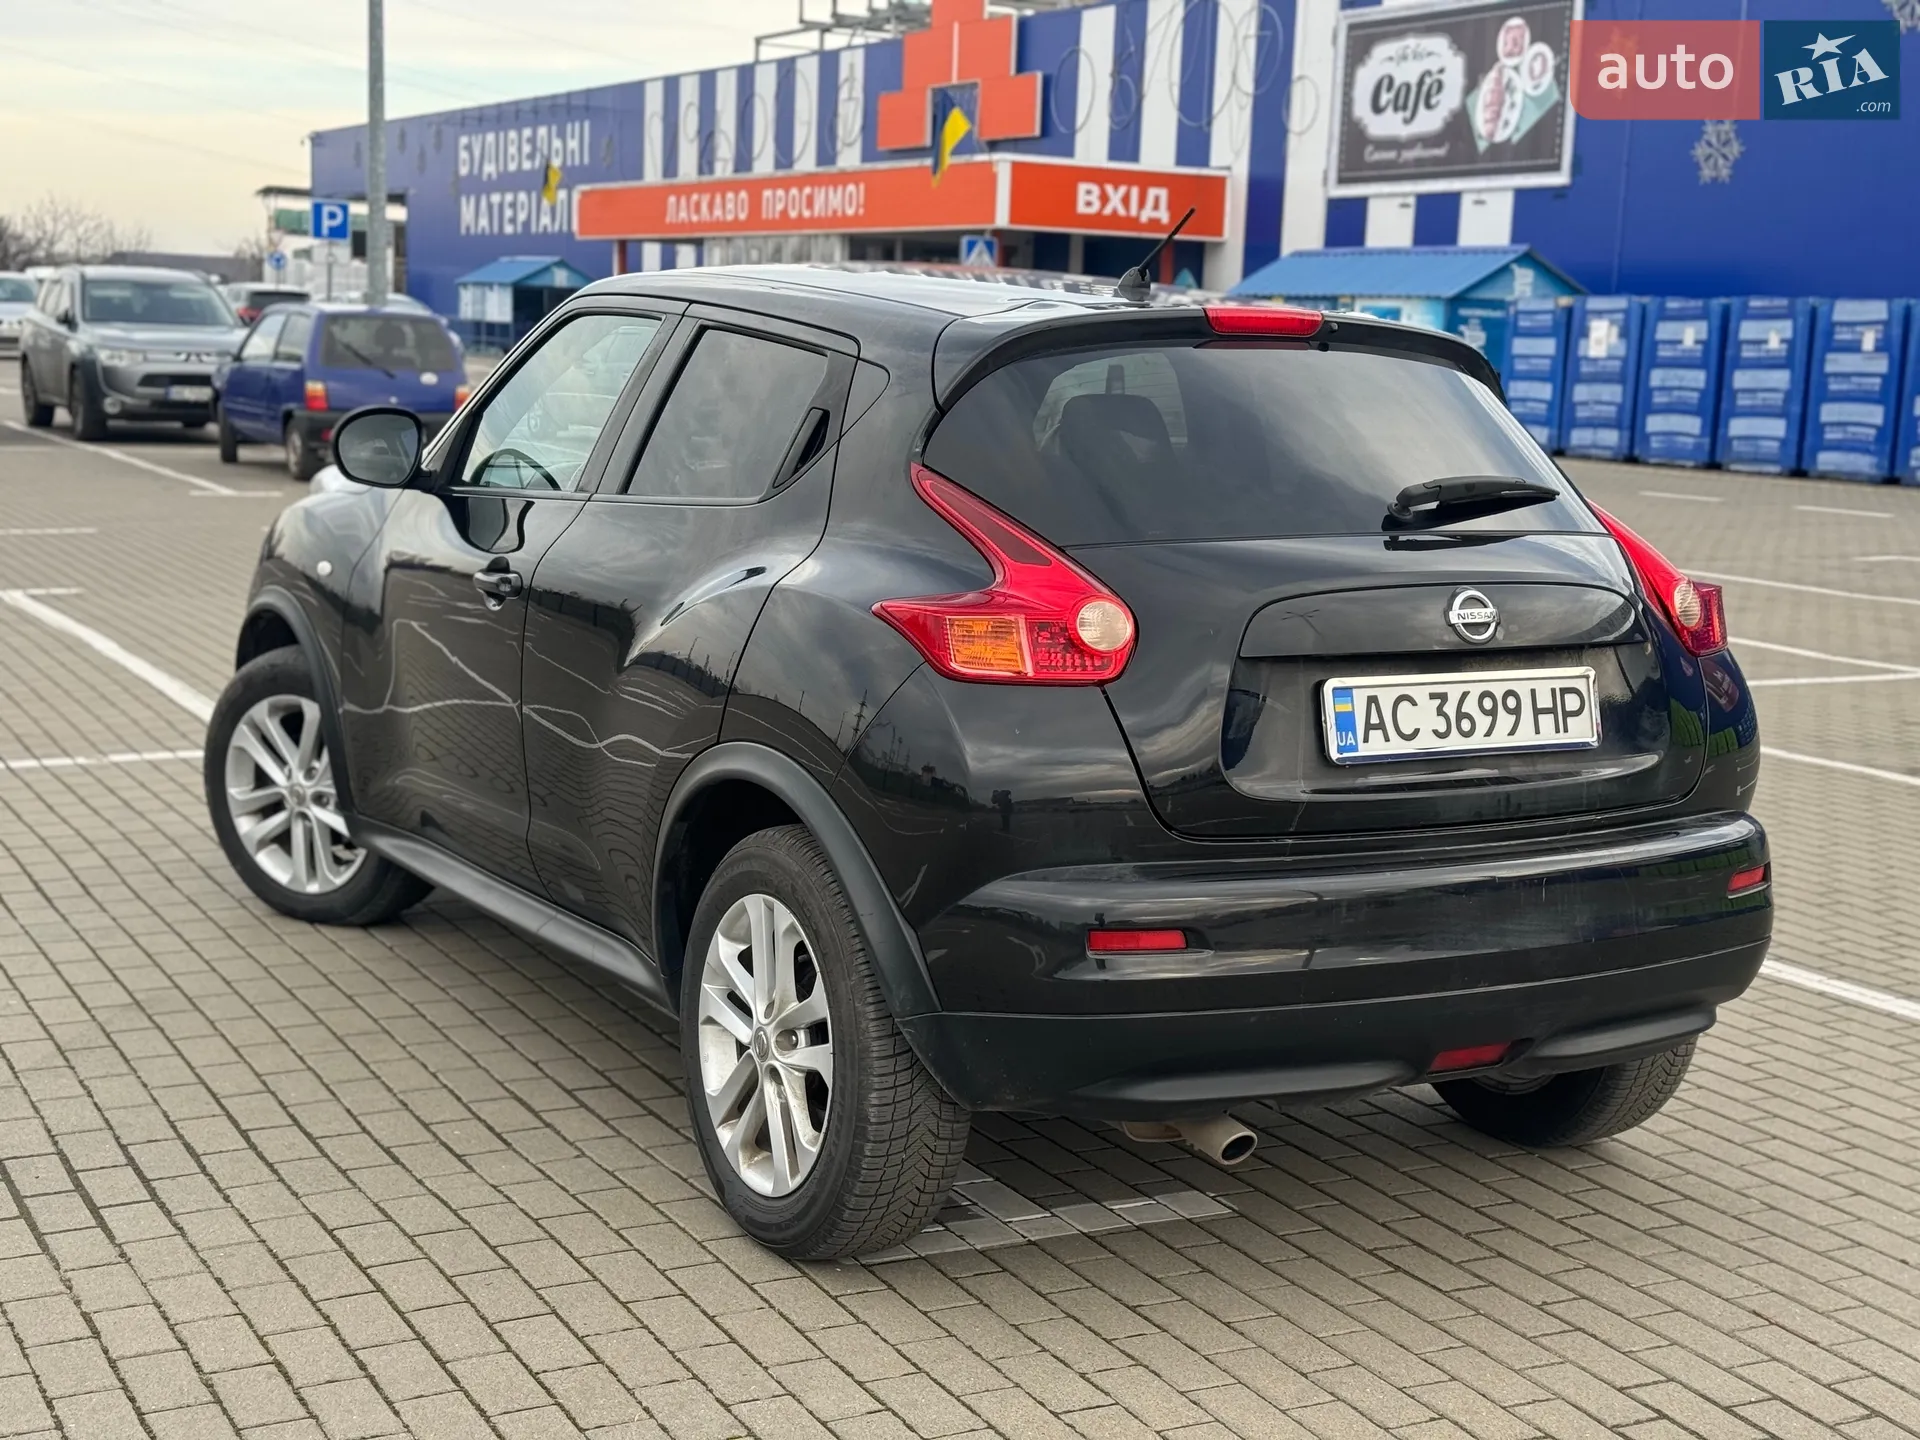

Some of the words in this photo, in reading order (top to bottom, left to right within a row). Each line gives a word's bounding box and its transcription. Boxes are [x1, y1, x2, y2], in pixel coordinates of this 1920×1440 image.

[1370, 67, 1445, 125] Café
[459, 119, 590, 181] БУДІВЕЛЬНІ
[321, 204, 344, 237] P
[460, 188, 577, 235] МАТЕРІАЛ
[665, 190, 749, 224] ЛАСКАВО
[761, 182, 866, 220] ПРОСИМО!
[1076, 181, 1170, 224] ВХІД
[1457, 610, 1495, 621] NISSAN
[1337, 730, 1356, 747] UA
